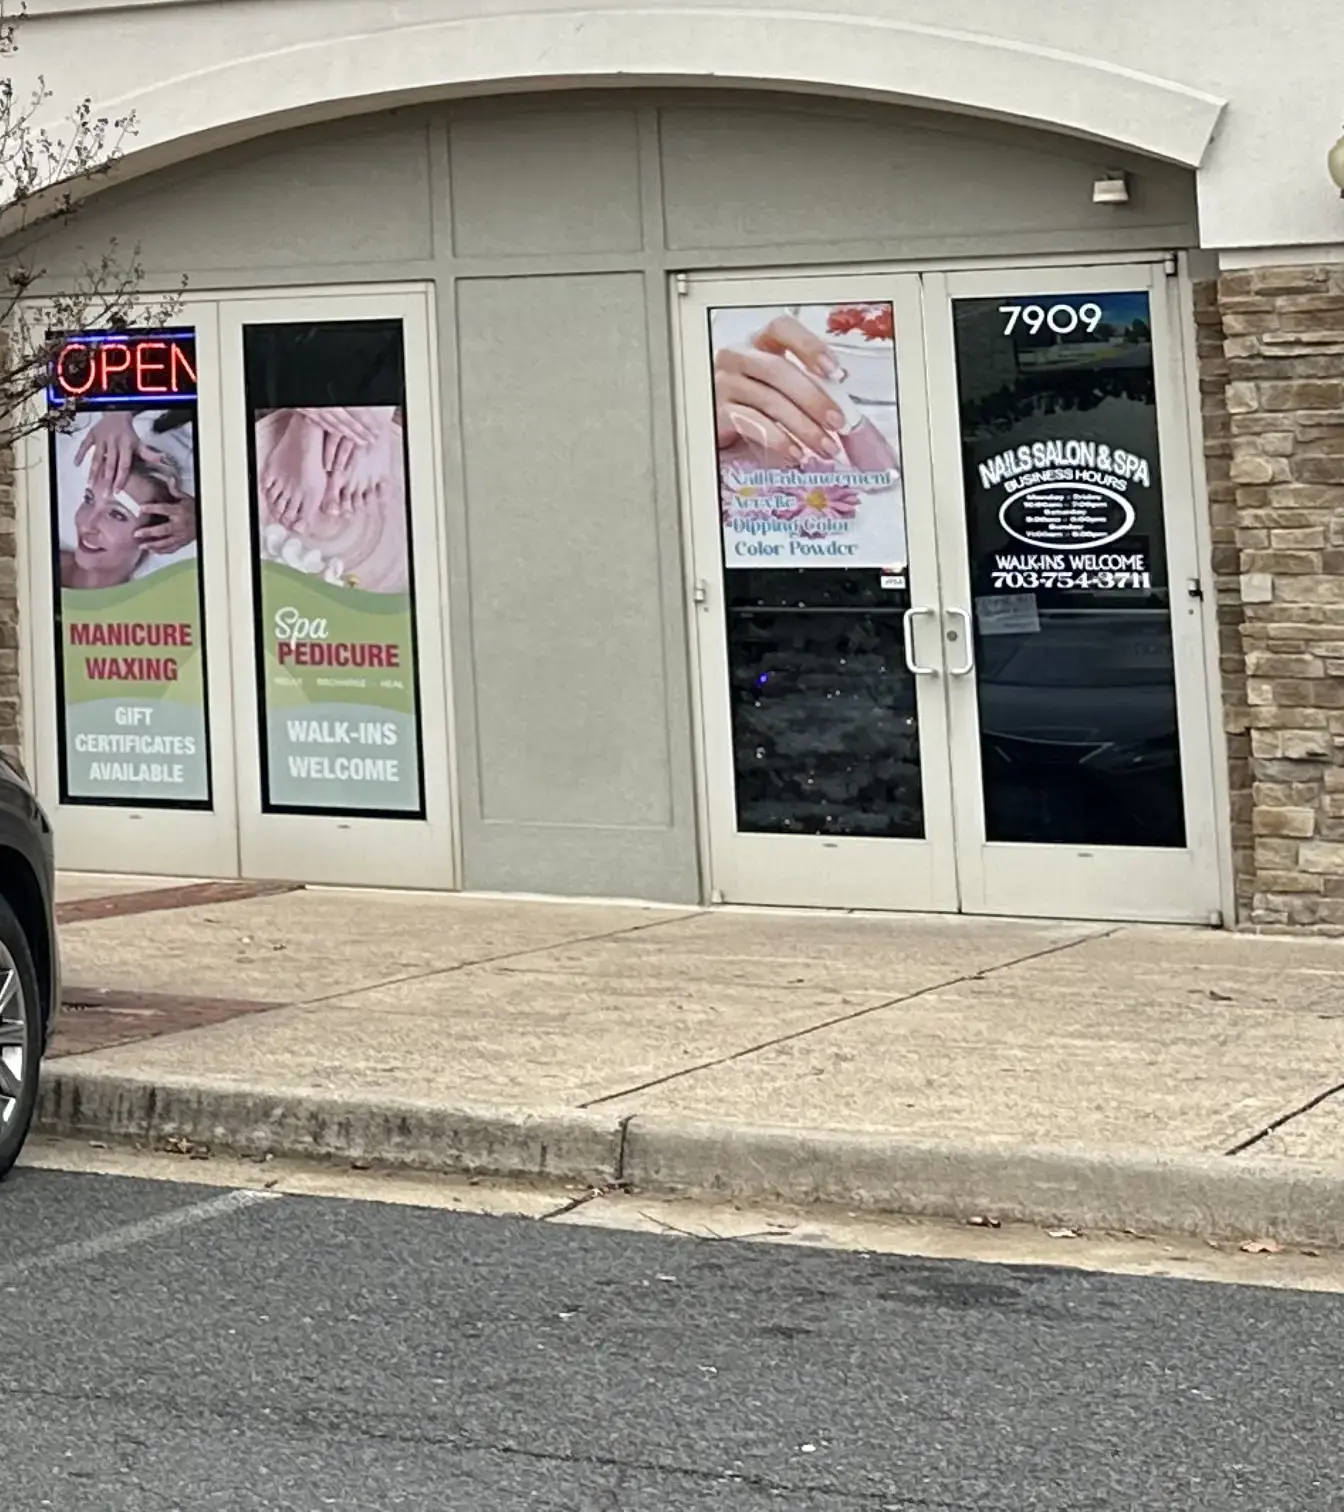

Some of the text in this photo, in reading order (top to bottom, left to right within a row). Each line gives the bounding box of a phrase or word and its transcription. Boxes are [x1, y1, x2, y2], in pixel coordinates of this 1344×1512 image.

[999, 304, 1102, 337] 7909
[978, 440, 1150, 489] NAILS SALON & SPA
[1004, 468, 1127, 493] BUSINESS HOURS
[735, 540, 858, 557] Color Powder
[996, 554, 1145, 571] WALK-INS WELCOME
[991, 572, 1150, 589] 703-754-3711
[70, 623, 192, 648] MANICURE
[274, 606, 329, 650] Spa
[277, 641, 400, 667] PEDICURE
[85, 657, 178, 681] WAXING
[114, 706, 153, 726] GIFT
[74, 733, 196, 755] CERTIFICATES
[286, 720, 398, 745] WALK-INS
[89, 761, 185, 783] AVAILABLE
[287, 755, 400, 781] WELCOME
